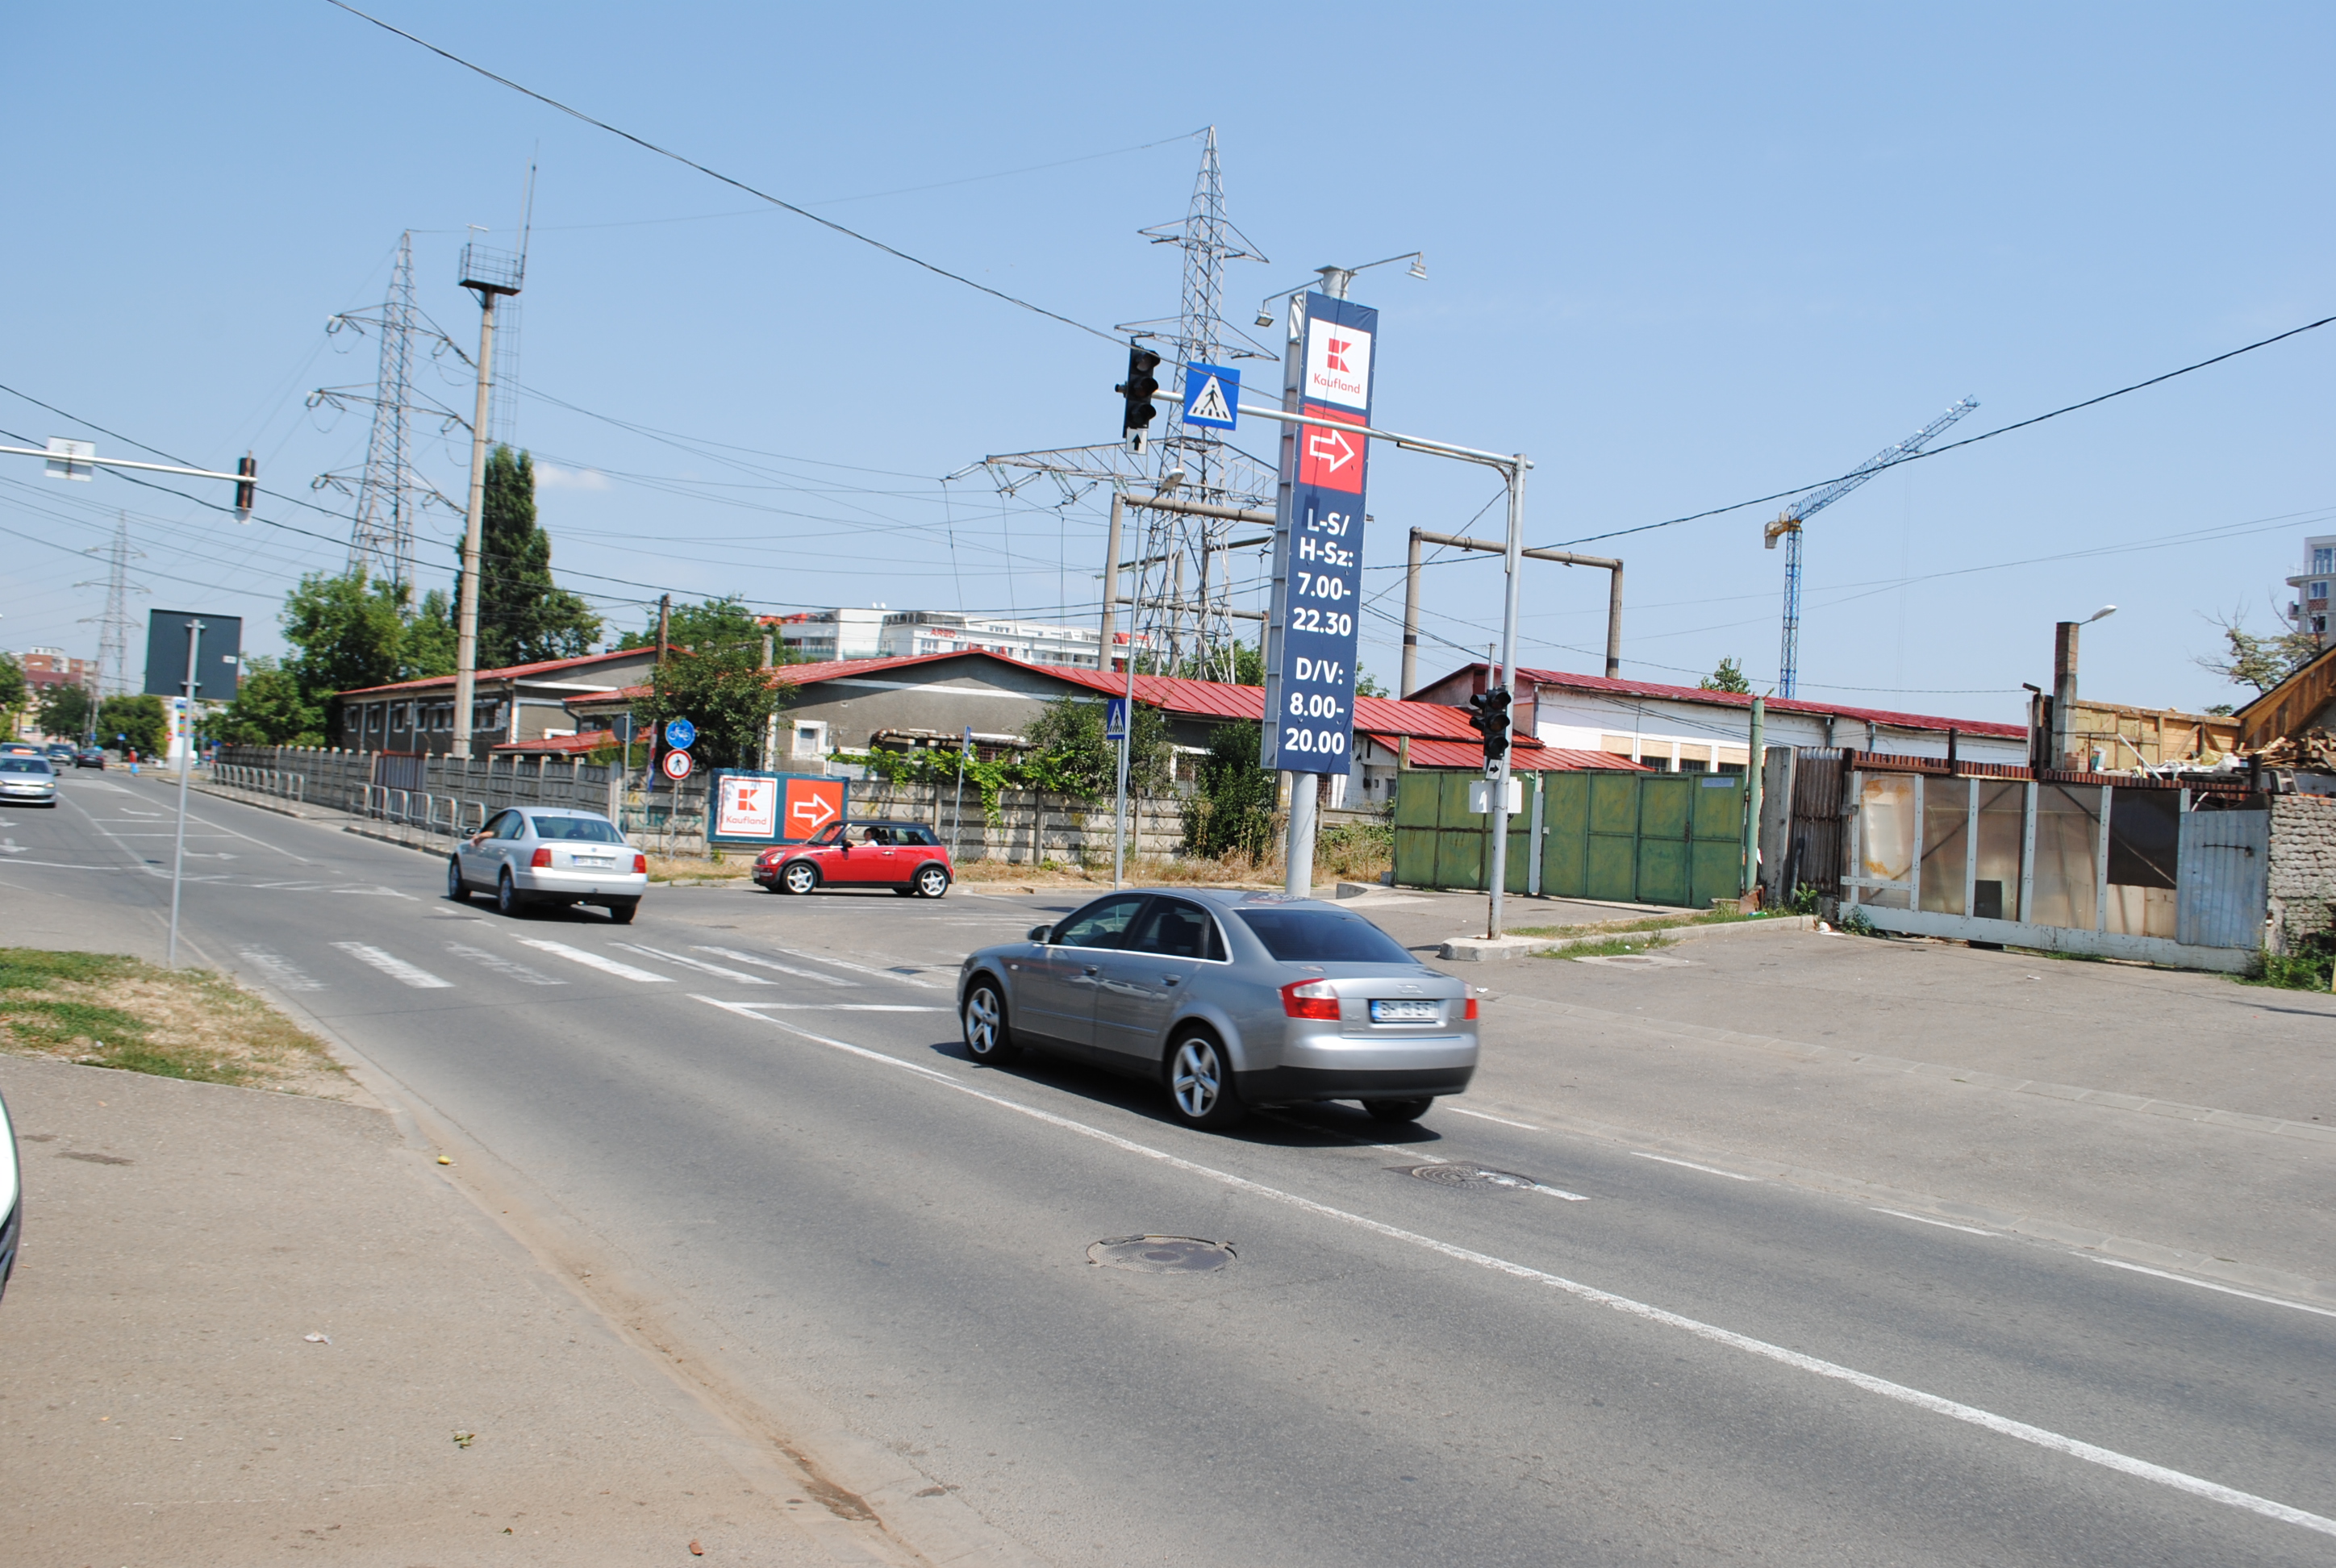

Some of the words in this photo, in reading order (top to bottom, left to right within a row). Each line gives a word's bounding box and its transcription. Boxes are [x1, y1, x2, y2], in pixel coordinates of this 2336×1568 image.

[1314, 373, 1361, 394] Kaufland
[1307, 508, 1350, 536] L-S/
[1299, 536, 1354, 568] H-Sz:
[1297, 572, 1351, 600] 7.00-
[1292, 607, 1352, 636] 22.30
[1295, 657, 1344, 685] D/V:
[1290, 692, 1345, 719] 8.00-
[1285, 728, 1345, 755] 20.00
[726, 815, 767, 825] Kaufland
